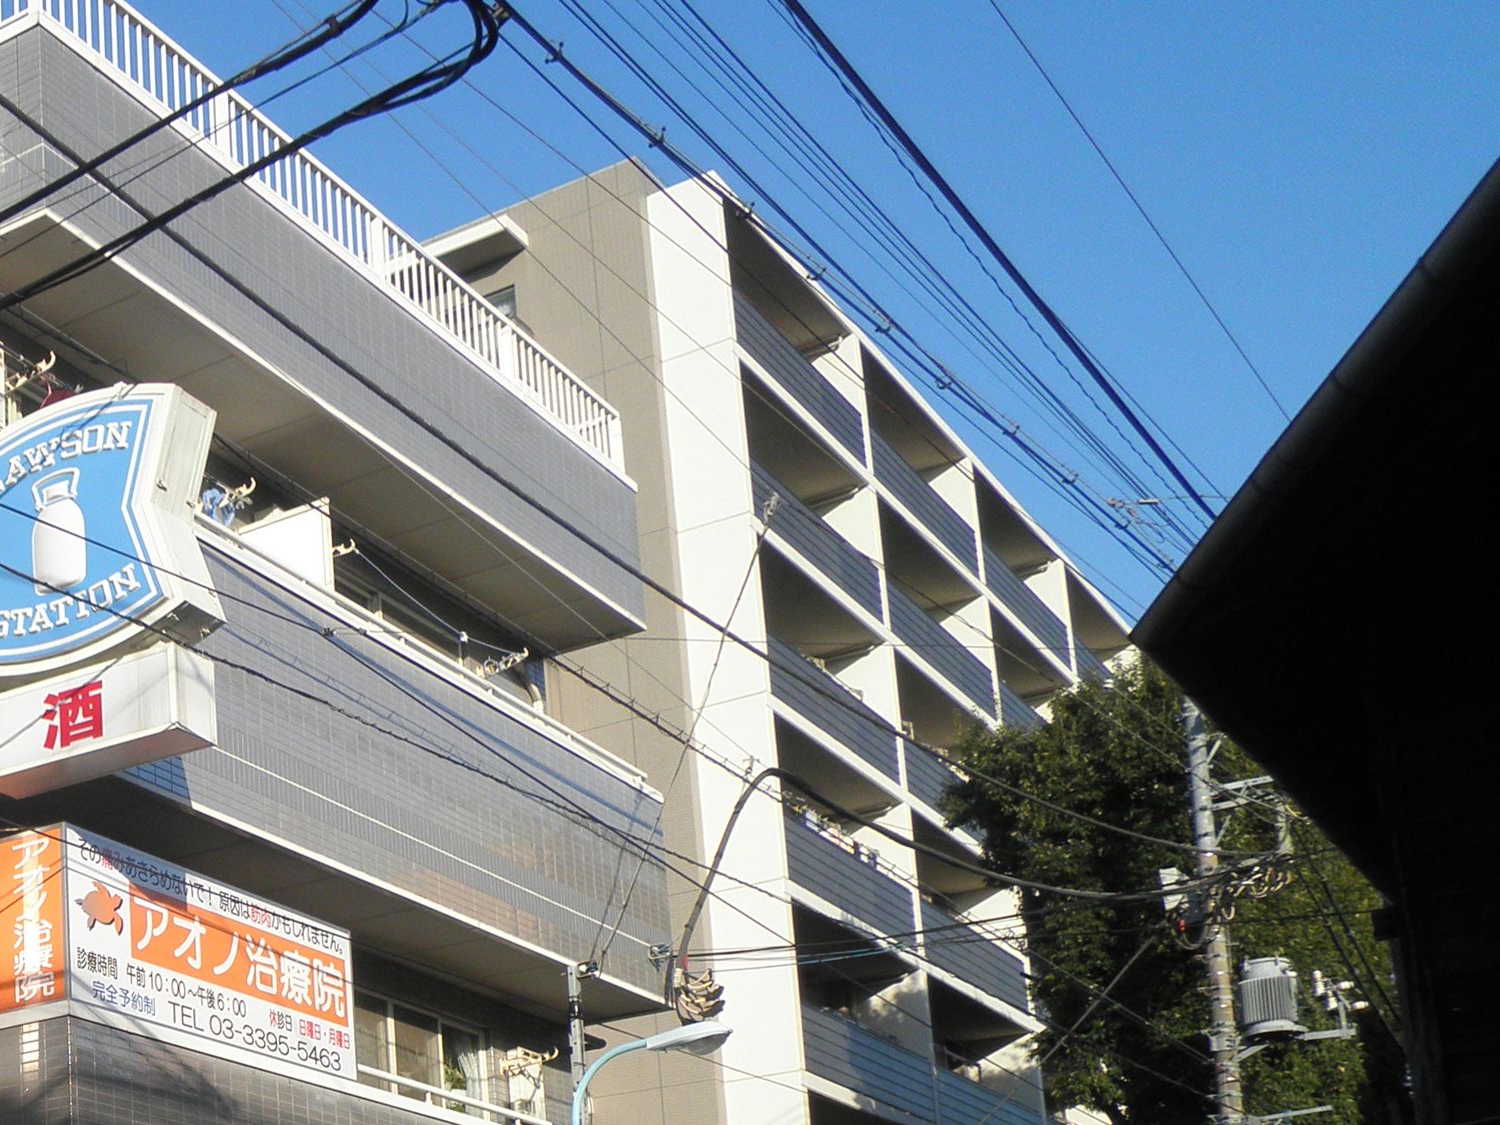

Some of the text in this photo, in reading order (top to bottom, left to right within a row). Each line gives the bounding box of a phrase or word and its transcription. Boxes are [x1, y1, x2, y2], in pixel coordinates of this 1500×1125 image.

[42, 679, 104, 751] 酒
[76, 946, 118, 981] 診療時間
[130, 896, 345, 1019] アオノ治療院
[92, 980, 156, 1016] 完全予約制
[167, 1000, 342, 1072] TEL 03-3395-5463
